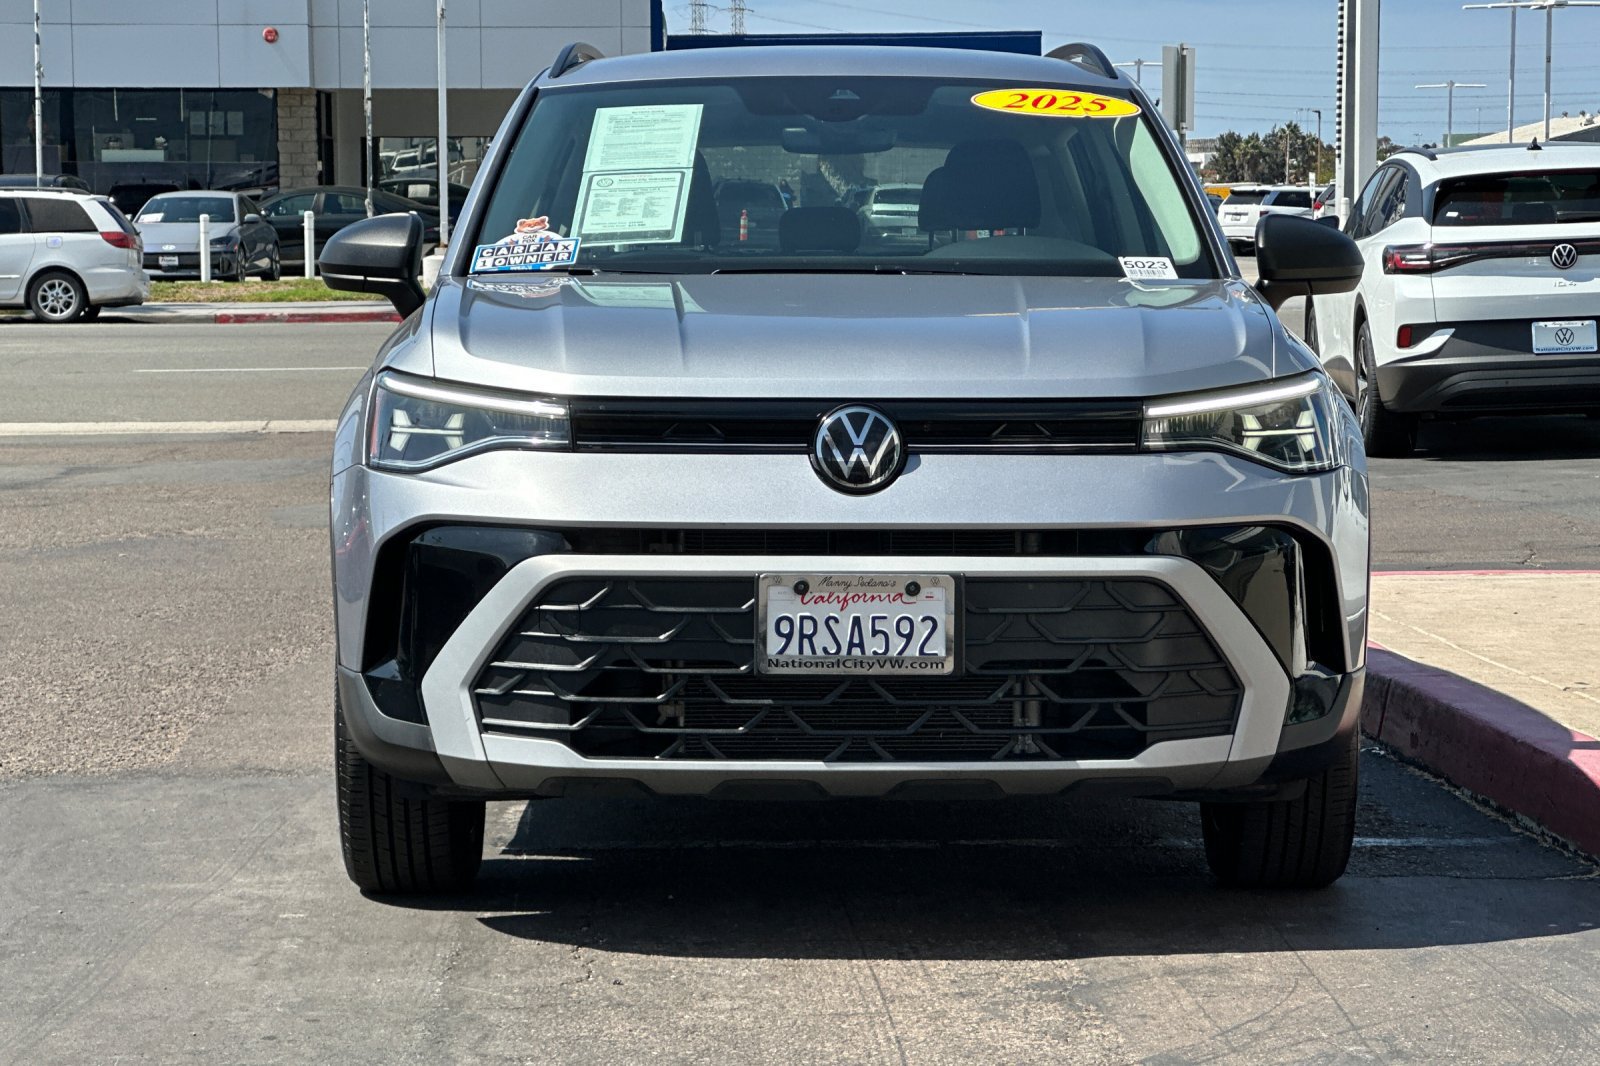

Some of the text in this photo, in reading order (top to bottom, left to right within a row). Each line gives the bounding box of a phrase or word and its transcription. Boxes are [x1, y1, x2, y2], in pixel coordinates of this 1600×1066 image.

[1003, 93, 1111, 112] 2025
[482, 242, 573, 257] CARFAX
[478, 252, 570, 267] 1 OWNER
[1123, 260, 1169, 270] 5023
[816, 405, 901, 488] VW
[818, 576, 853, 592] Manny
[800, 591, 917, 612] California
[773, 614, 940, 657] 9RSA592
[767, 657, 945, 671] NationalCityVW.com
